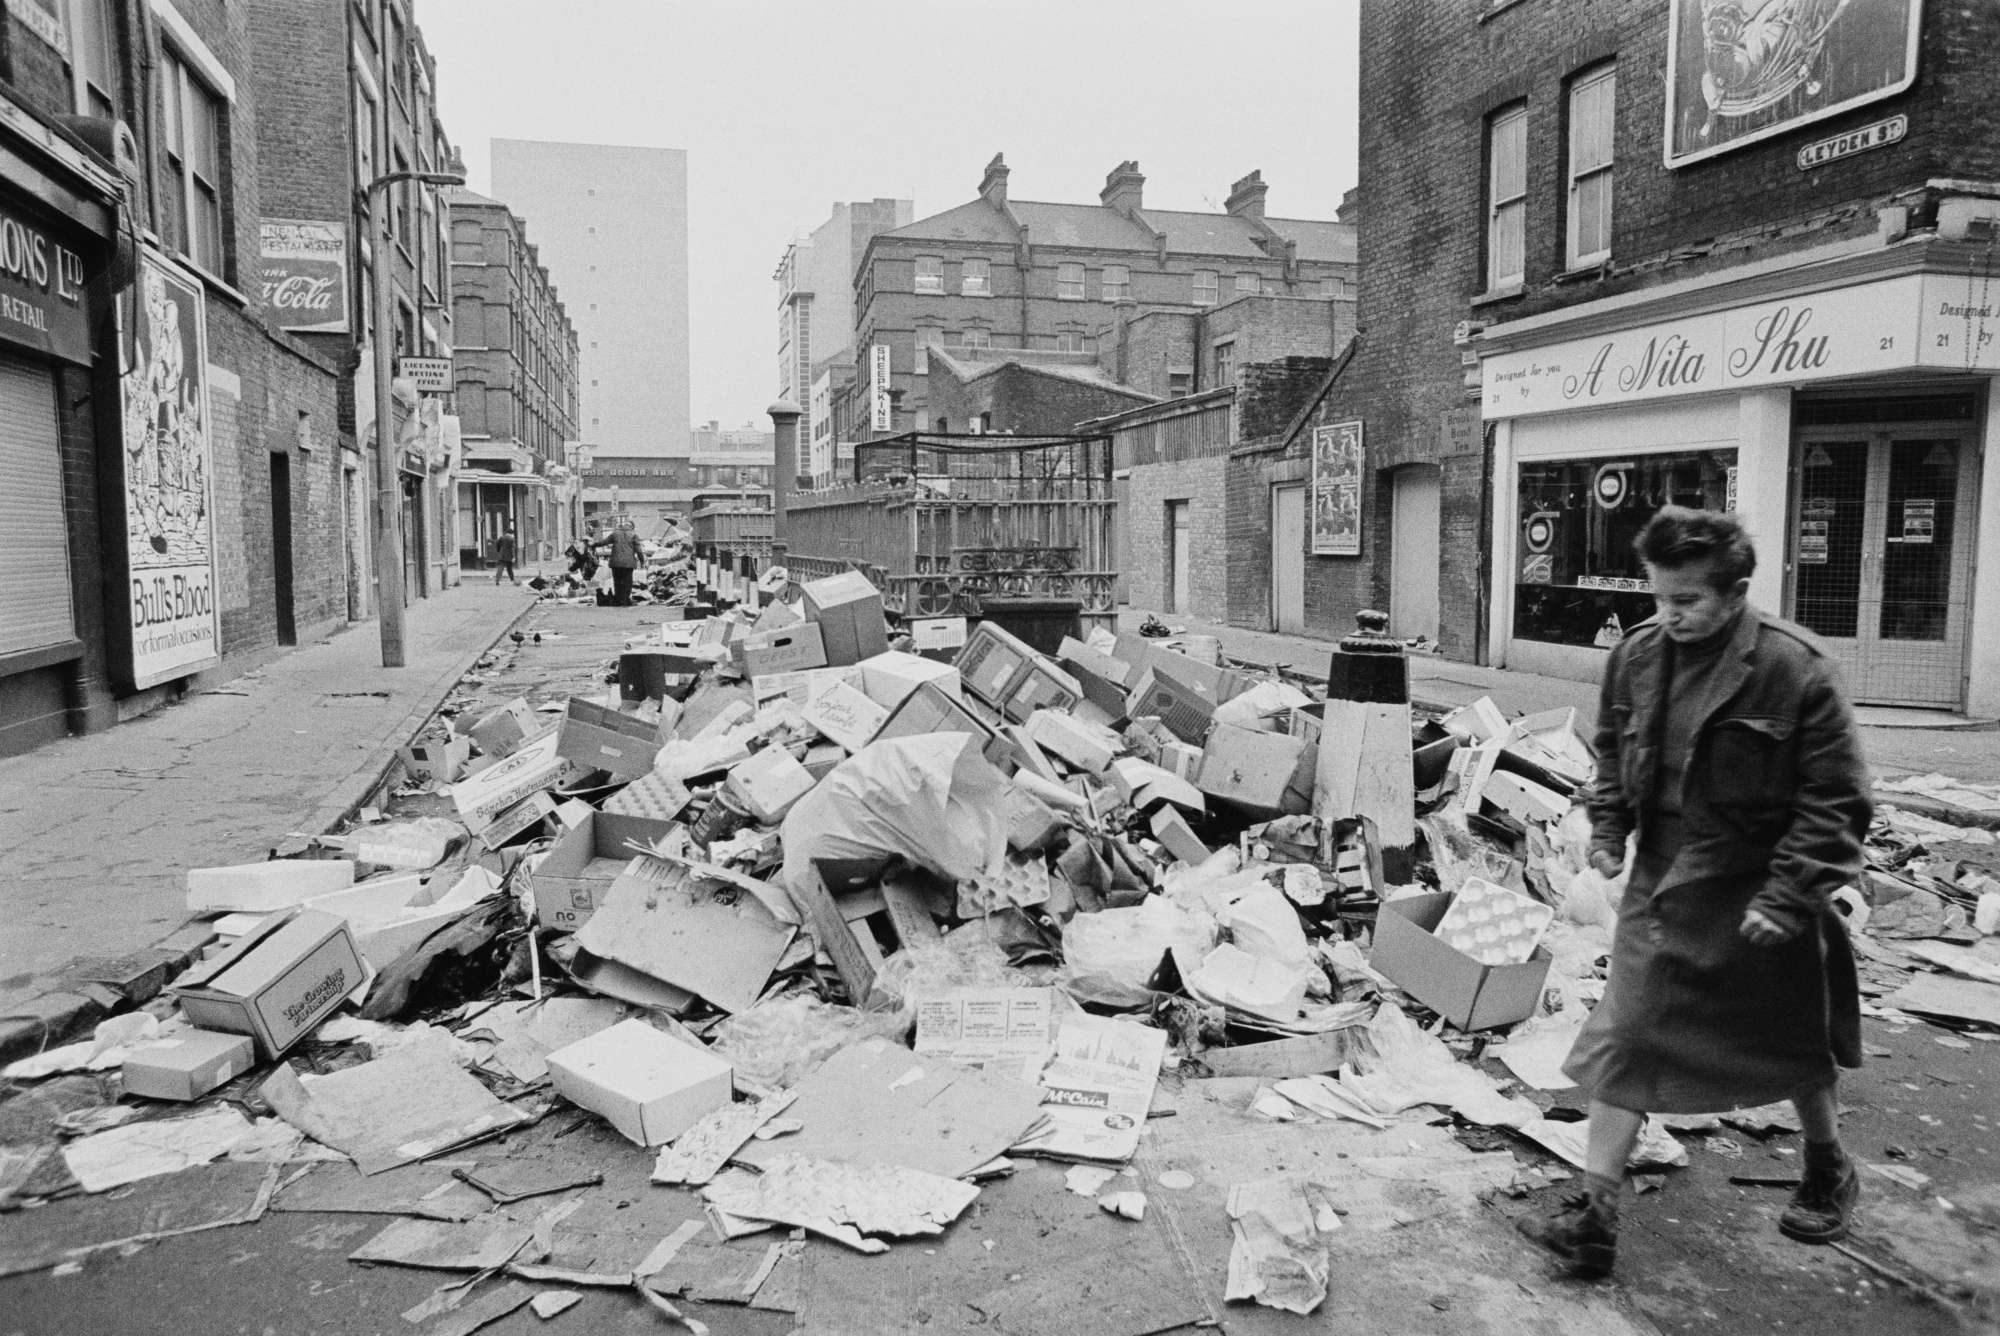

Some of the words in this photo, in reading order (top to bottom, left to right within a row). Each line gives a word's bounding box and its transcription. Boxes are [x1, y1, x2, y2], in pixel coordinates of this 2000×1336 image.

[1805, 131, 1870, 164] LEYDEN
[1, 293, 48, 332] RETAIL
[1940, 302, 1992, 319] Designed
[1936, 334, 1949, 347] 21
[1978, 328, 1994, 346] by
[1562, 342, 1614, 400] A
[1618, 334, 1706, 393] Nita
[1728, 306, 1831, 378] Shu
[1880, 337, 1894, 350] 21
[404, 362, 449, 370] LICENSED
[408, 370, 444, 378] BETTING
[1494, 367, 1527, 383] Designed
[1530, 363, 1542, 376] for
[1546, 365, 1561, 377] you
[877, 346, 886, 425] SHEEPSKINS
[1520, 386, 1530, 399] by
[1492, 394, 1500, 404] 21
[1453, 441, 1469, 452] Tea
[173, 573, 212, 621] Blood
[283, 1002, 305, 1021] The
[303, 968, 345, 1005] Growing
[291, 981, 345, 1028] Partnership
[1046, 1089, 1106, 1108] McCain
